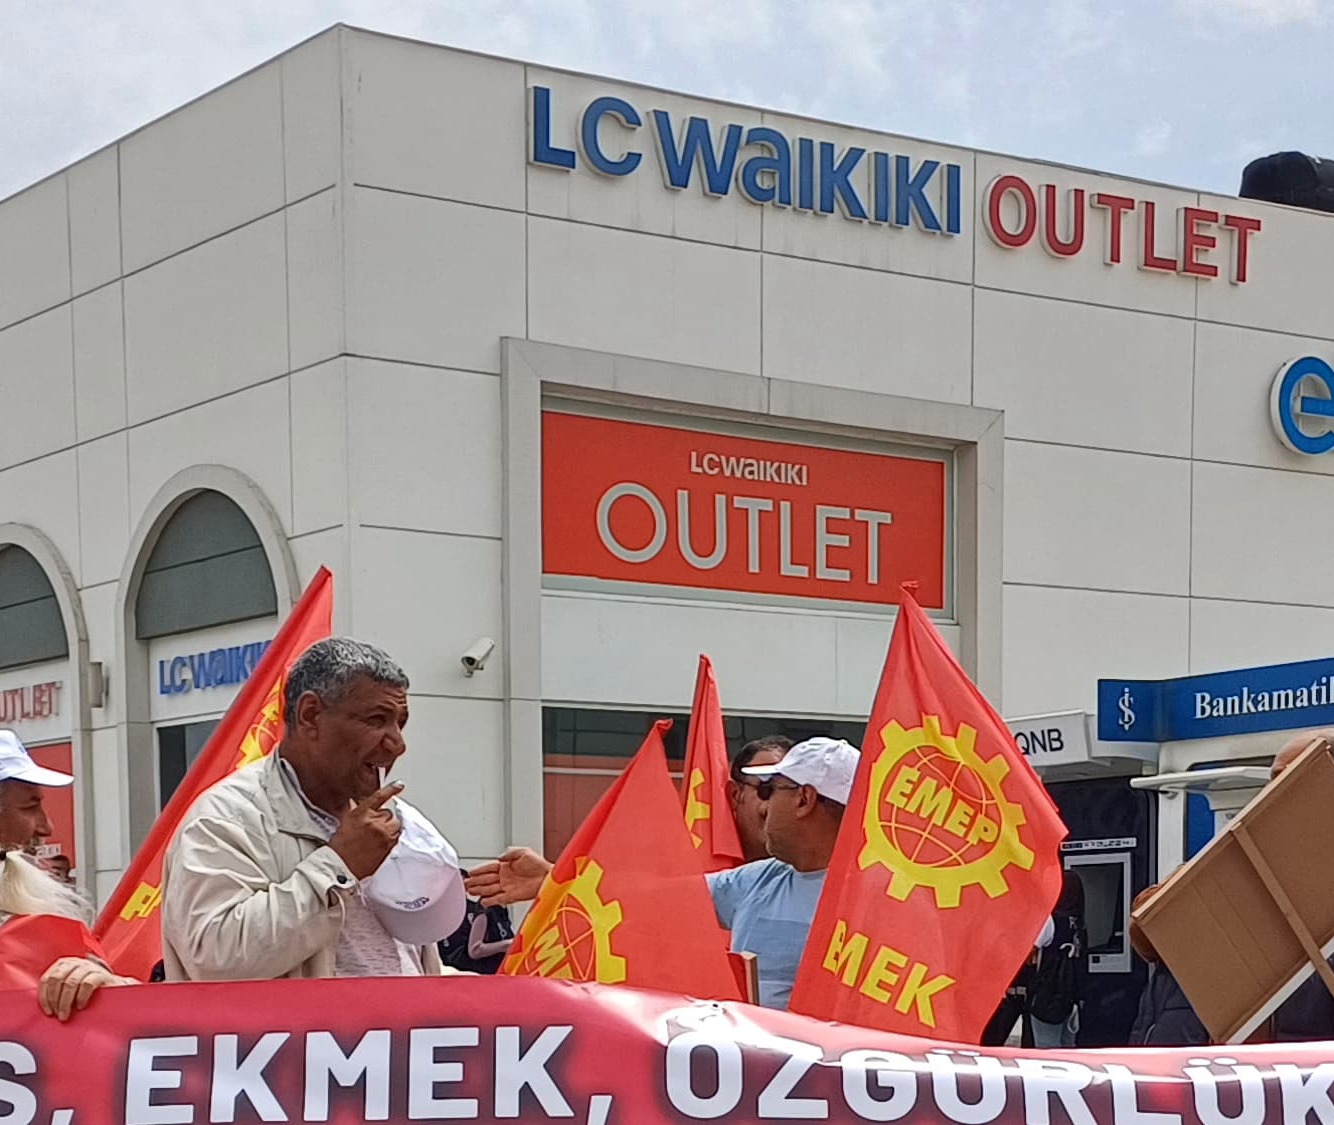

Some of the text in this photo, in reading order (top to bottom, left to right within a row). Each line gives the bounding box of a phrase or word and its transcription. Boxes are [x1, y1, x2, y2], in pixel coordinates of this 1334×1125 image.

[530, 85, 643, 178] LC
[984, 175, 1262, 284] OUTLET
[595, 482, 893, 585] OUTLET
[1016, 727, 1065, 757] QNB
[886, 766, 999, 847] EMEP
